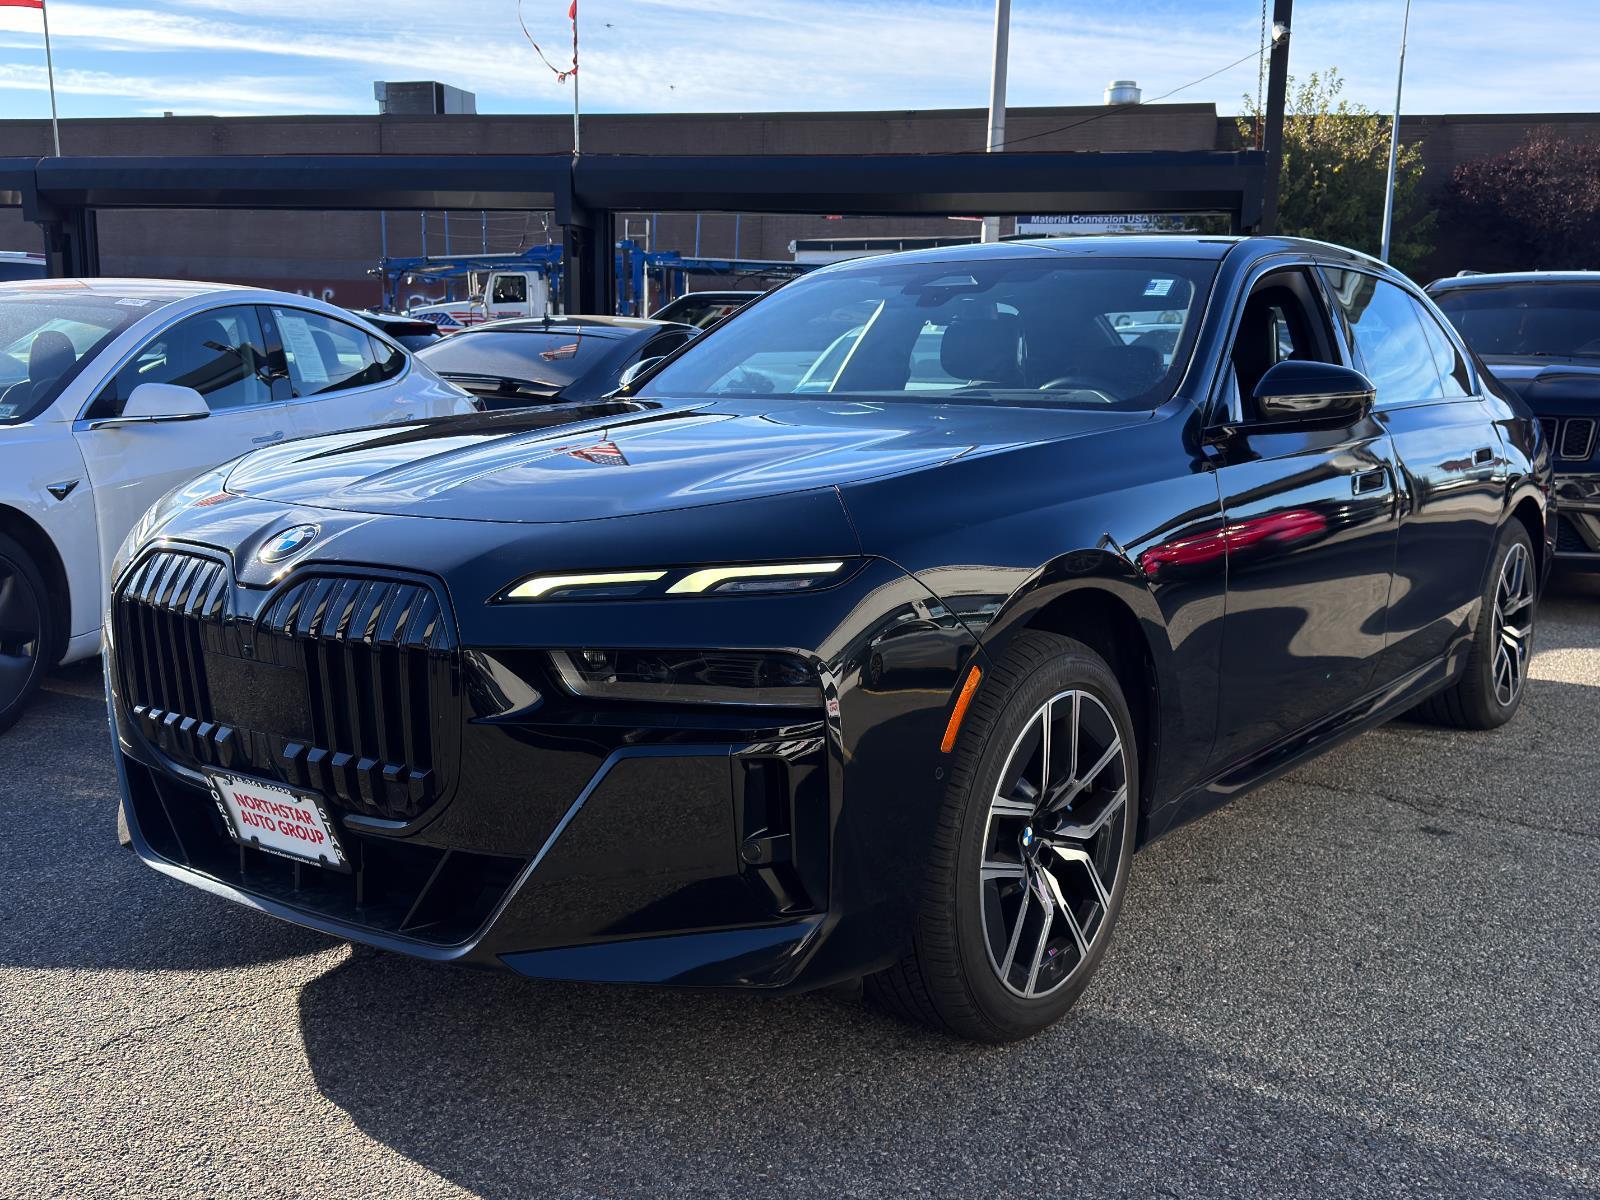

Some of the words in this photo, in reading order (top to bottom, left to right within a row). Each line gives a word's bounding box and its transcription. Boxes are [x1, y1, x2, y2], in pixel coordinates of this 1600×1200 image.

[1031, 215, 1069, 224] Material
[1071, 214, 1125, 224] Connexion
[1127, 213, 1150, 223] USA
[204, 776, 238, 839] NORTH
[233, 792, 316, 827] NORTHSTAR
[241, 810, 276, 832] AUTO
[278, 820, 325, 845] GROUP
[318, 807, 346, 862] STAR
